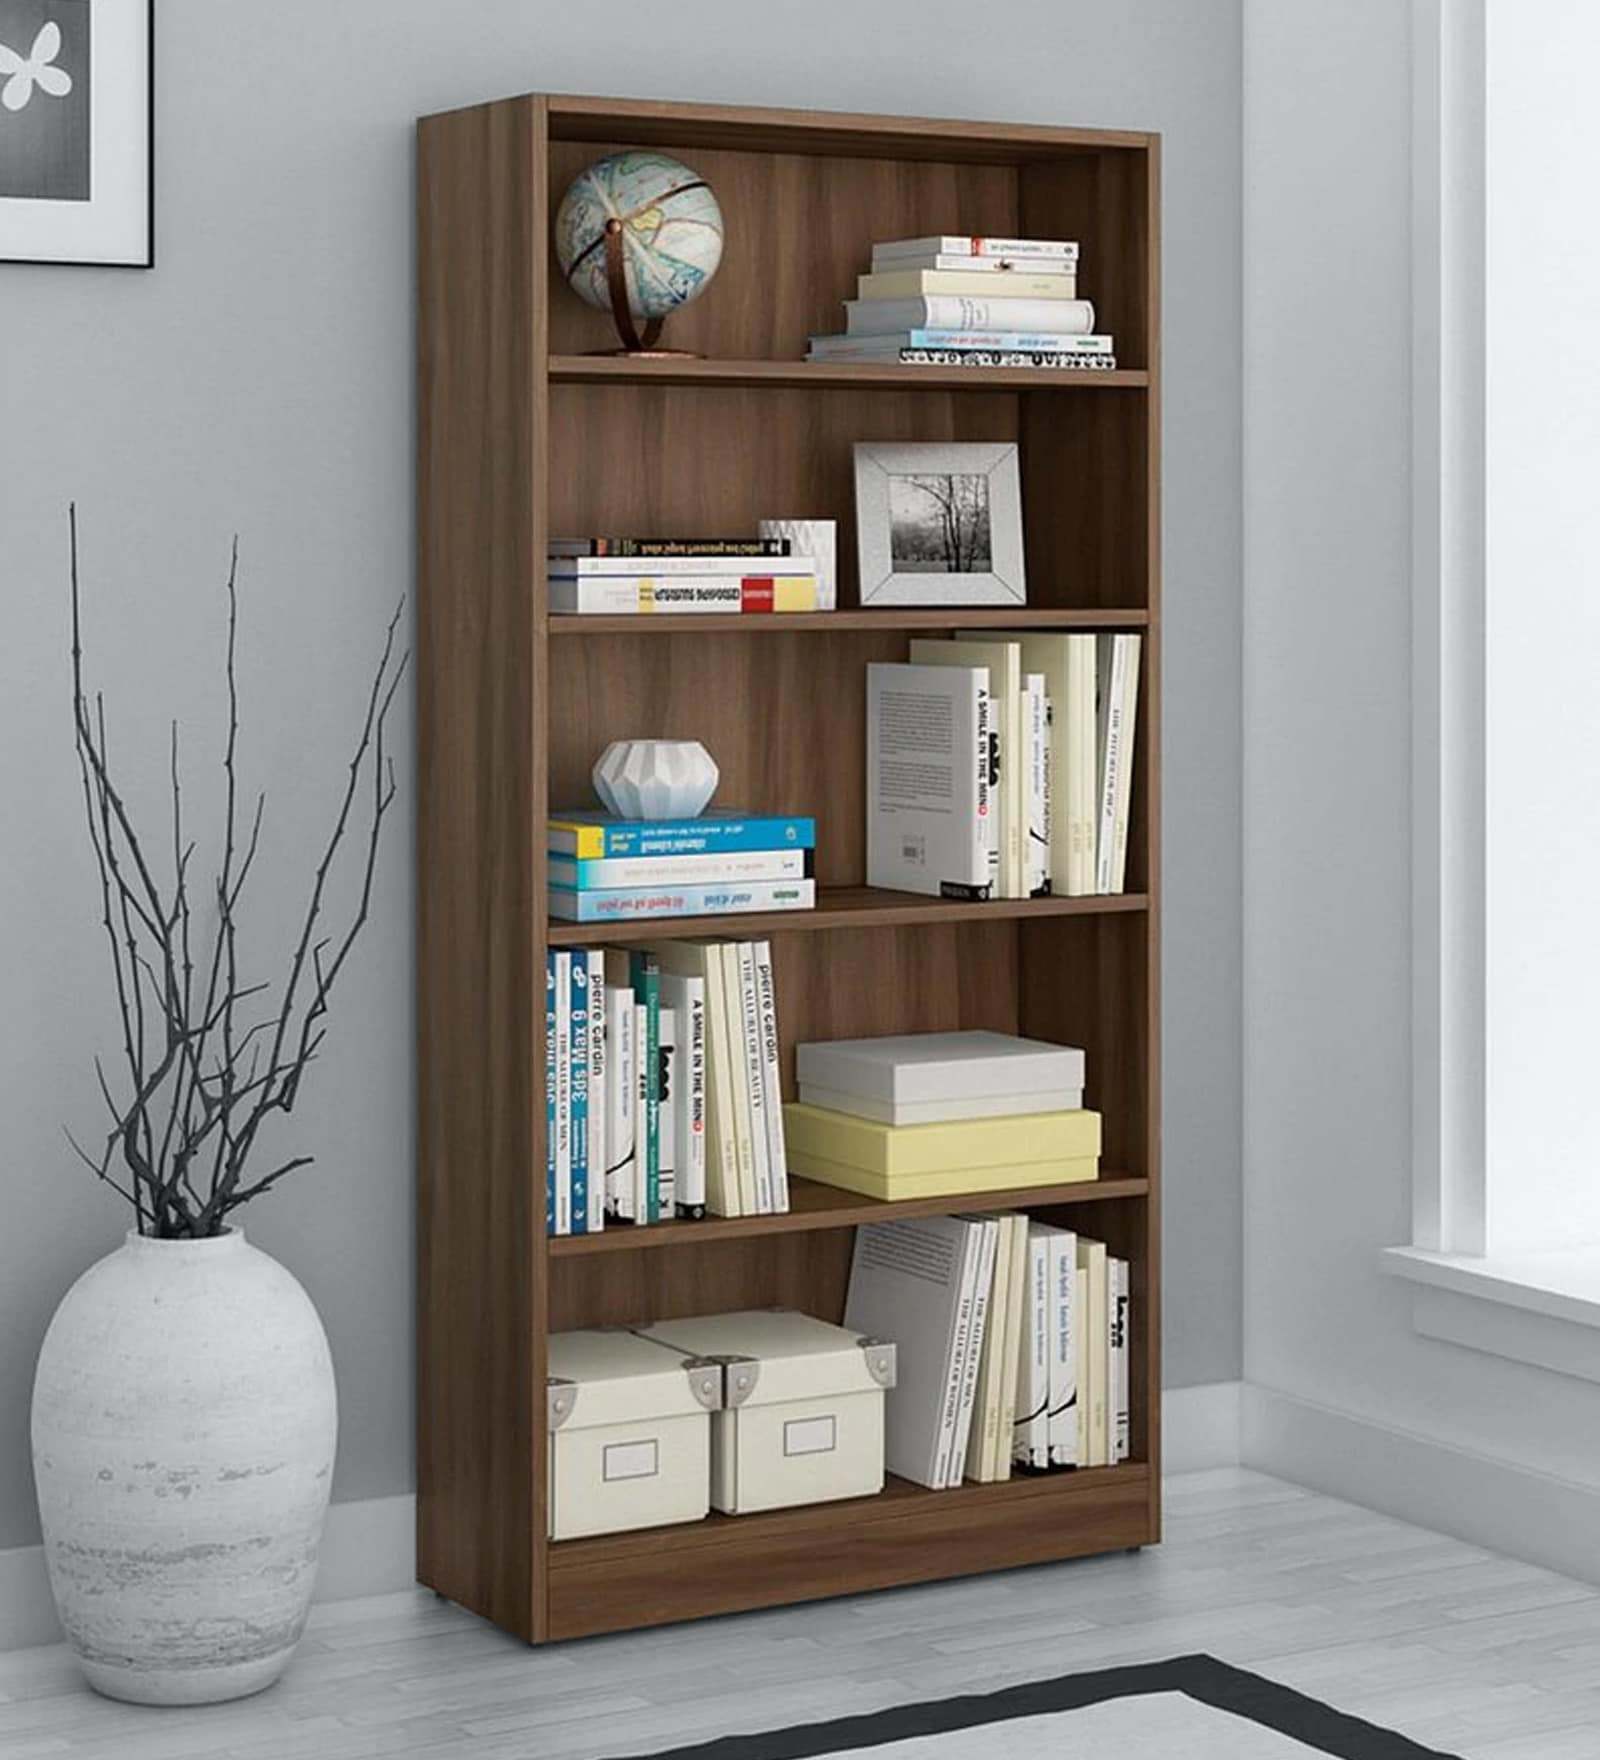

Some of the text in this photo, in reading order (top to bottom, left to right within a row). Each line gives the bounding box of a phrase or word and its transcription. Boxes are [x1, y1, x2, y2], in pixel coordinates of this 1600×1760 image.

[978, 689, 988, 816] A SMILE IN THE MIND
[571, 1026, 587, 1064] Max
[591, 974, 603, 1076] pierre cardin
[759, 964, 777, 1064] pierre cardin
[571, 1069, 587, 1103] 3ds
[692, 1000, 704, 1132] A SMILE IN THE MIND
